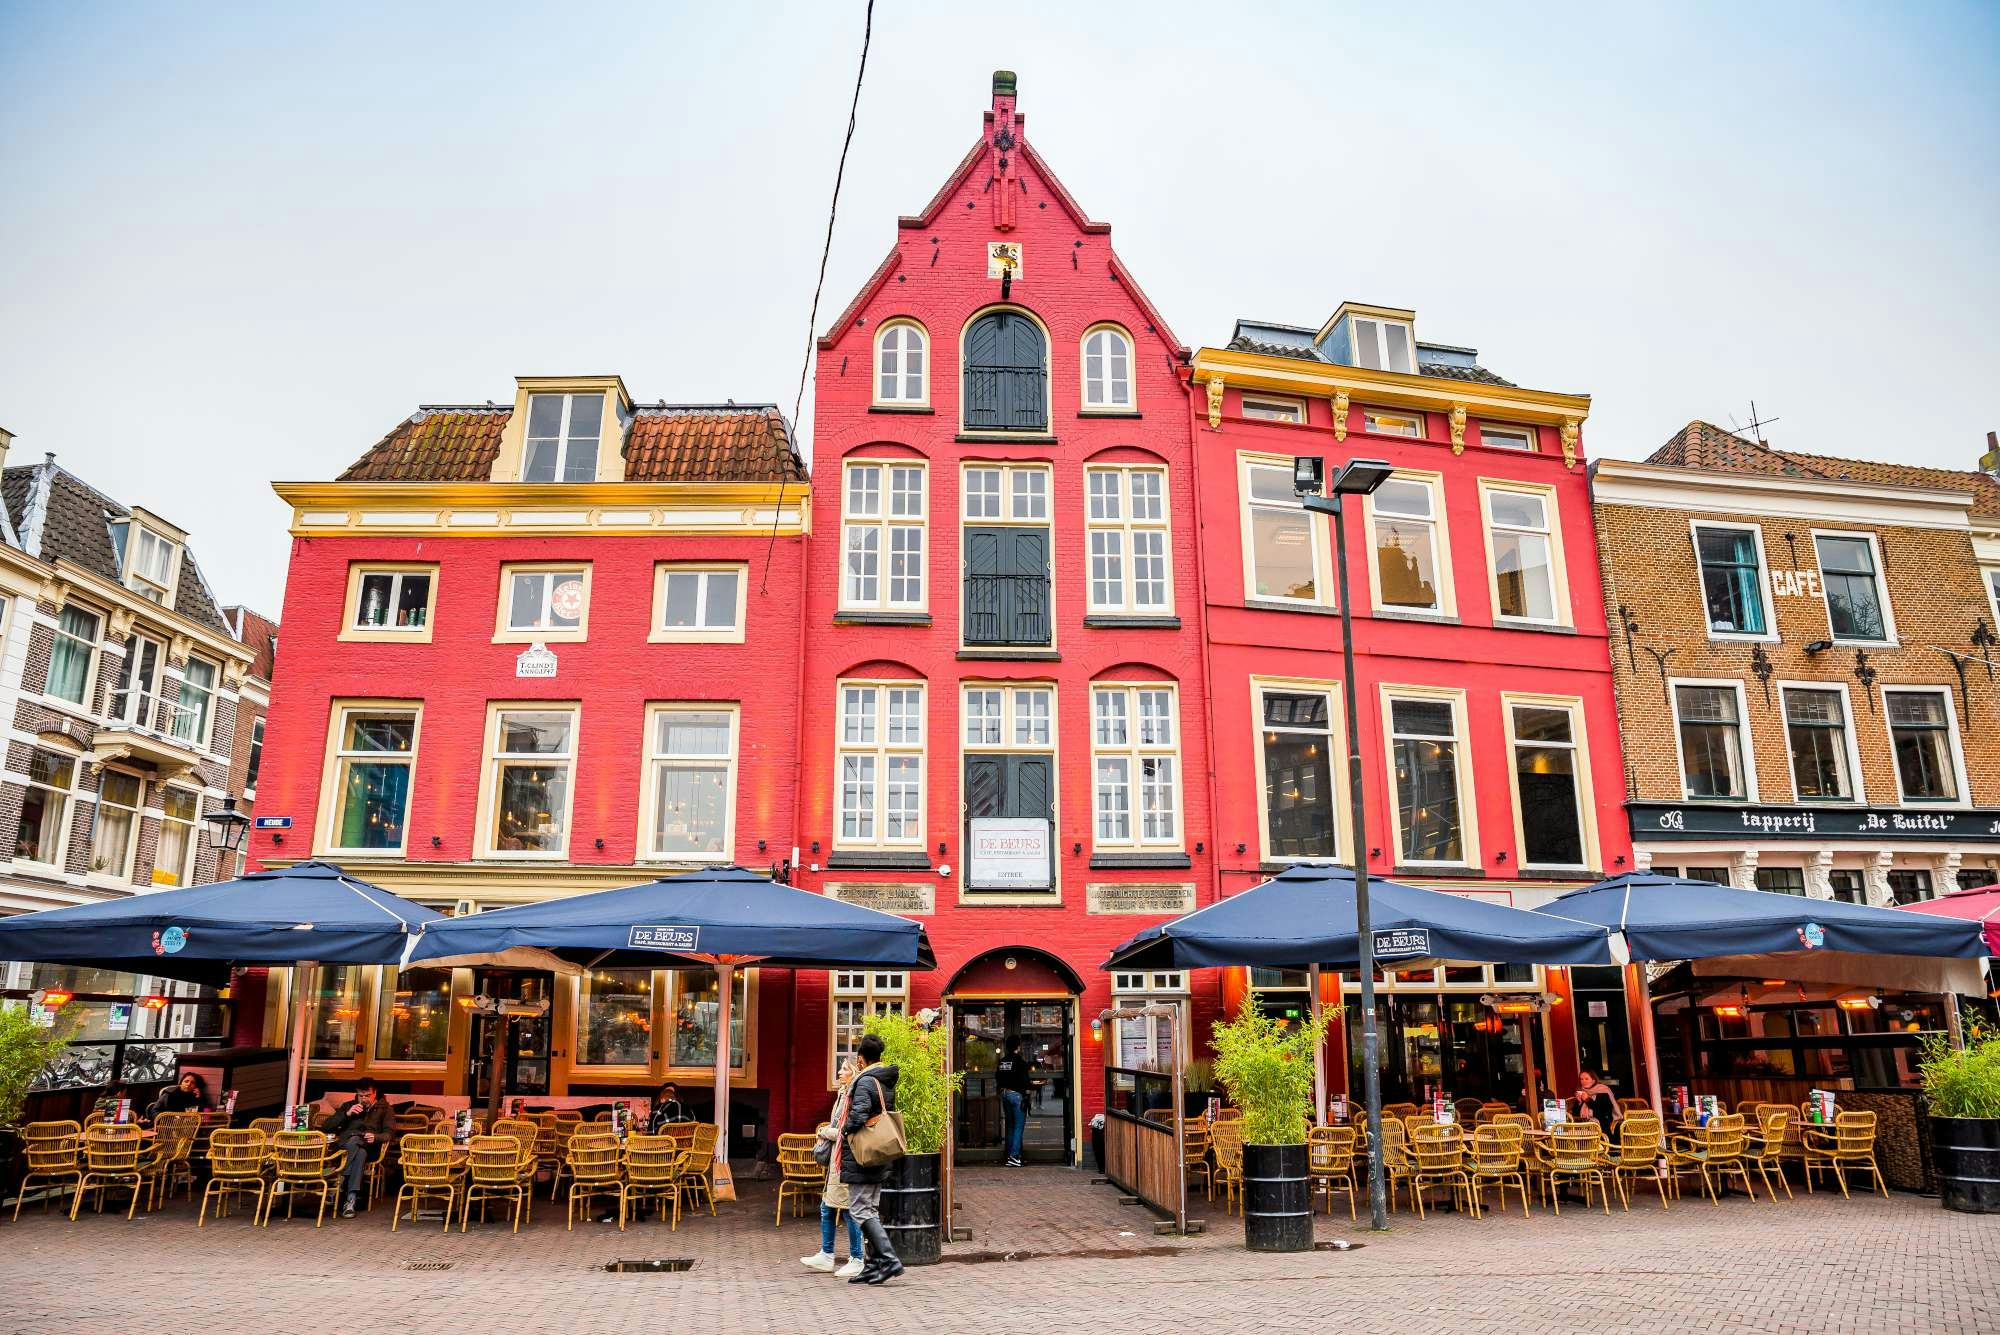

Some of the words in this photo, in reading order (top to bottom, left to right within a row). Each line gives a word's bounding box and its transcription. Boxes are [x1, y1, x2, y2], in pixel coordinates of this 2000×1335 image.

[1742, 811, 1815, 832] tapperij
[979, 838, 996, 850] DE
[1000, 838, 1041, 850] BEURS
[635, 931, 652, 940] DE
[654, 931, 693, 942] BEURS
[1376, 937, 1391, 948] DE
[1392, 935, 1425, 947] BEURS
